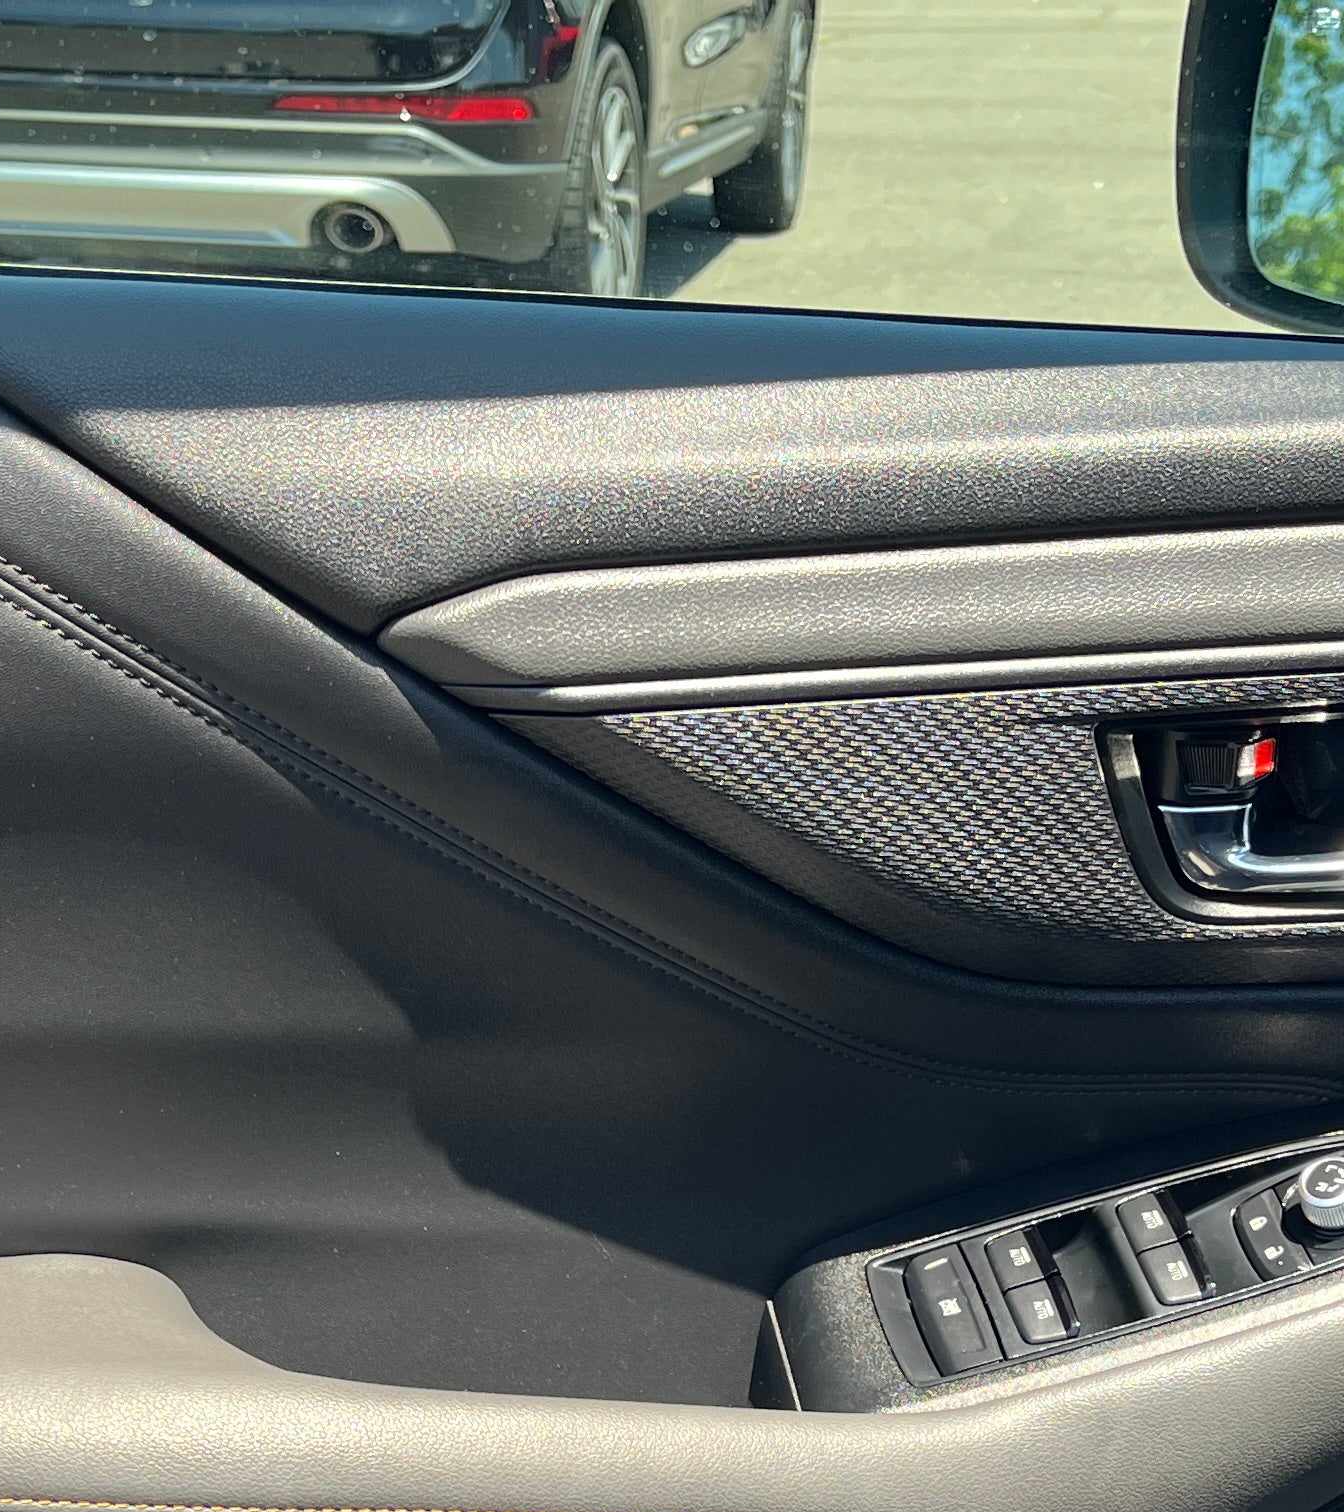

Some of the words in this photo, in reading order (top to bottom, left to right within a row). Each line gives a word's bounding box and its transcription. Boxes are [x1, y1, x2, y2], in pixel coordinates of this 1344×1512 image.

[1141, 1210, 1158, 1229] AUTO
[1009, 1248, 1026, 1266] AUTO
[1167, 1262, 1183, 1281] AUTO
[1032, 1300, 1049, 1320] AUTO
